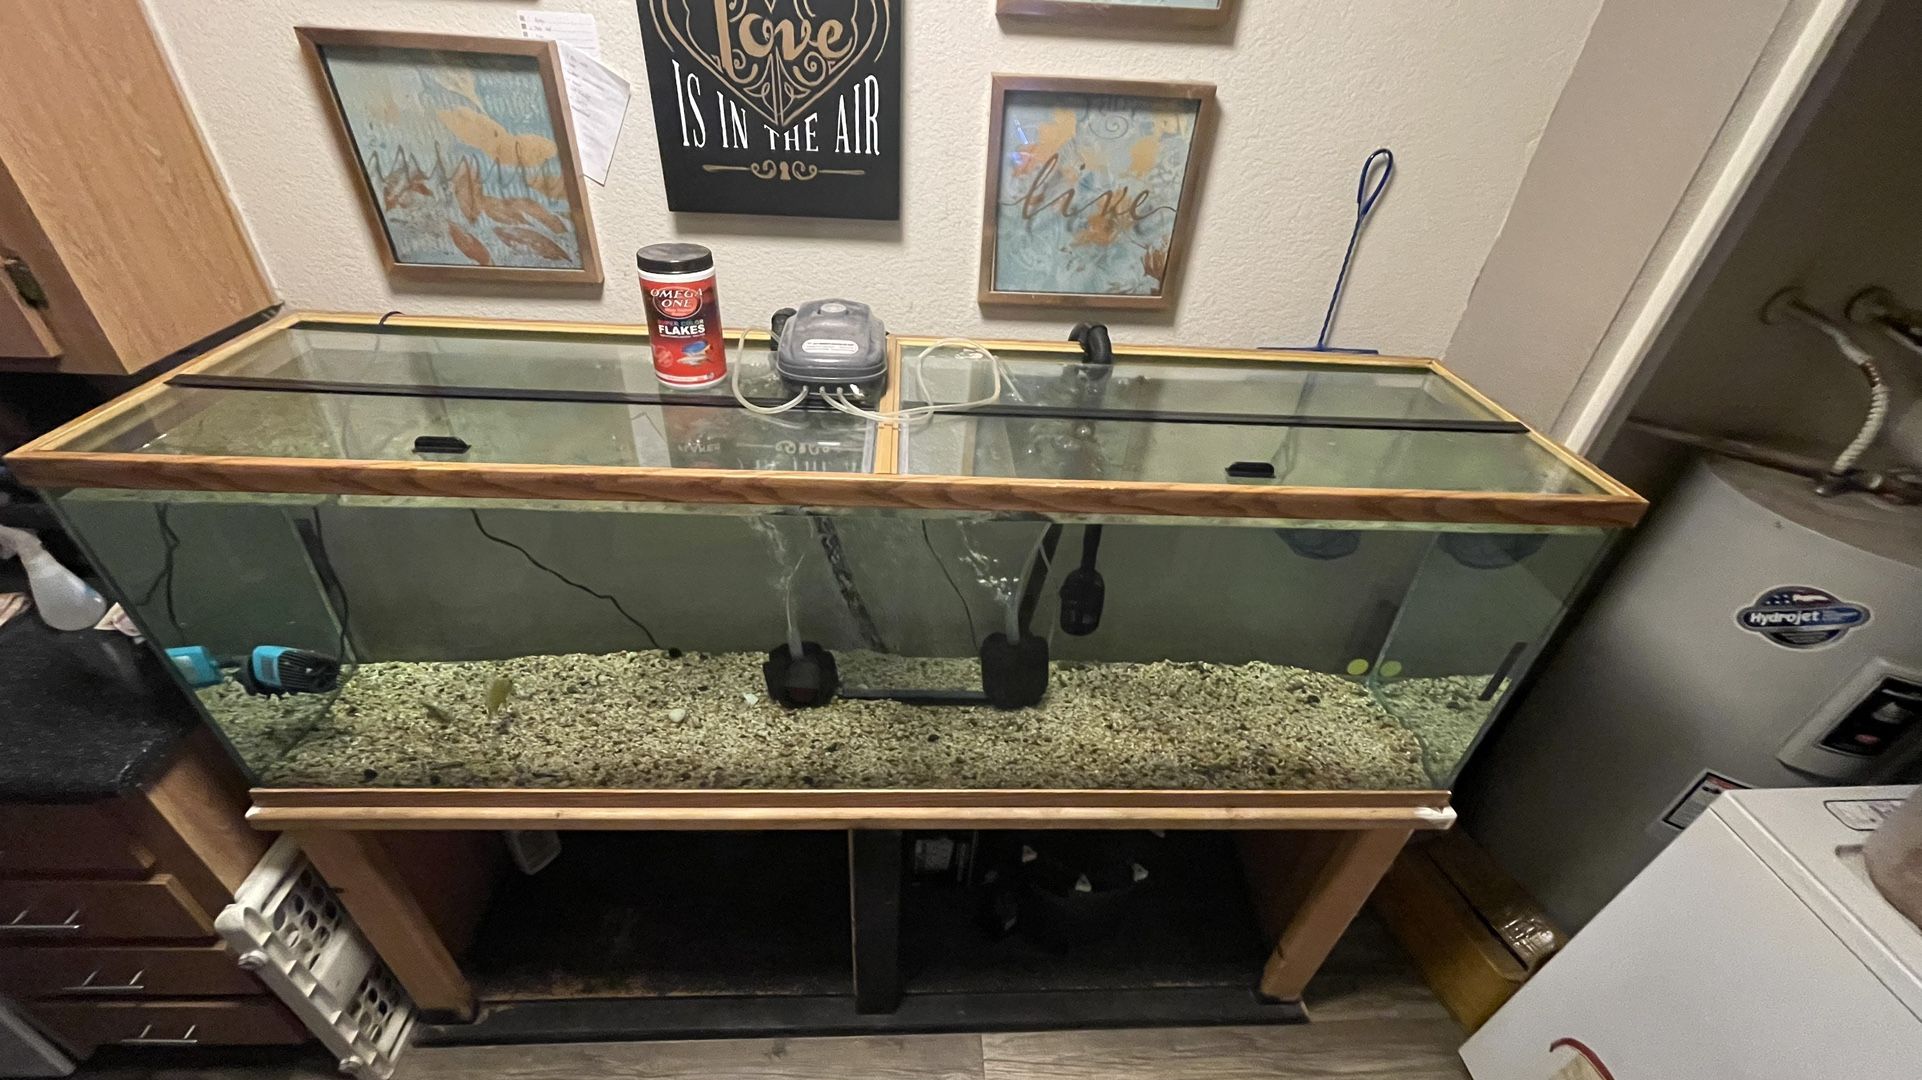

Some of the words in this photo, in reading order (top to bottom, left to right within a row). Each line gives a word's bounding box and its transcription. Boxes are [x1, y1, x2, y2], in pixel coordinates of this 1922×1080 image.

[672, 59, 706, 148] IS
[717, 91, 748, 149] IN
[764, 112, 819, 152] THE
[835, 75, 880, 156] AIR
[1001, 153, 1177, 220] live
[650, 288, 703, 299] OMEGA
[661, 299, 691, 308] ONE
[658, 324, 705, 335] FLAKES
[1750, 611, 1820, 626] Hydrojet
